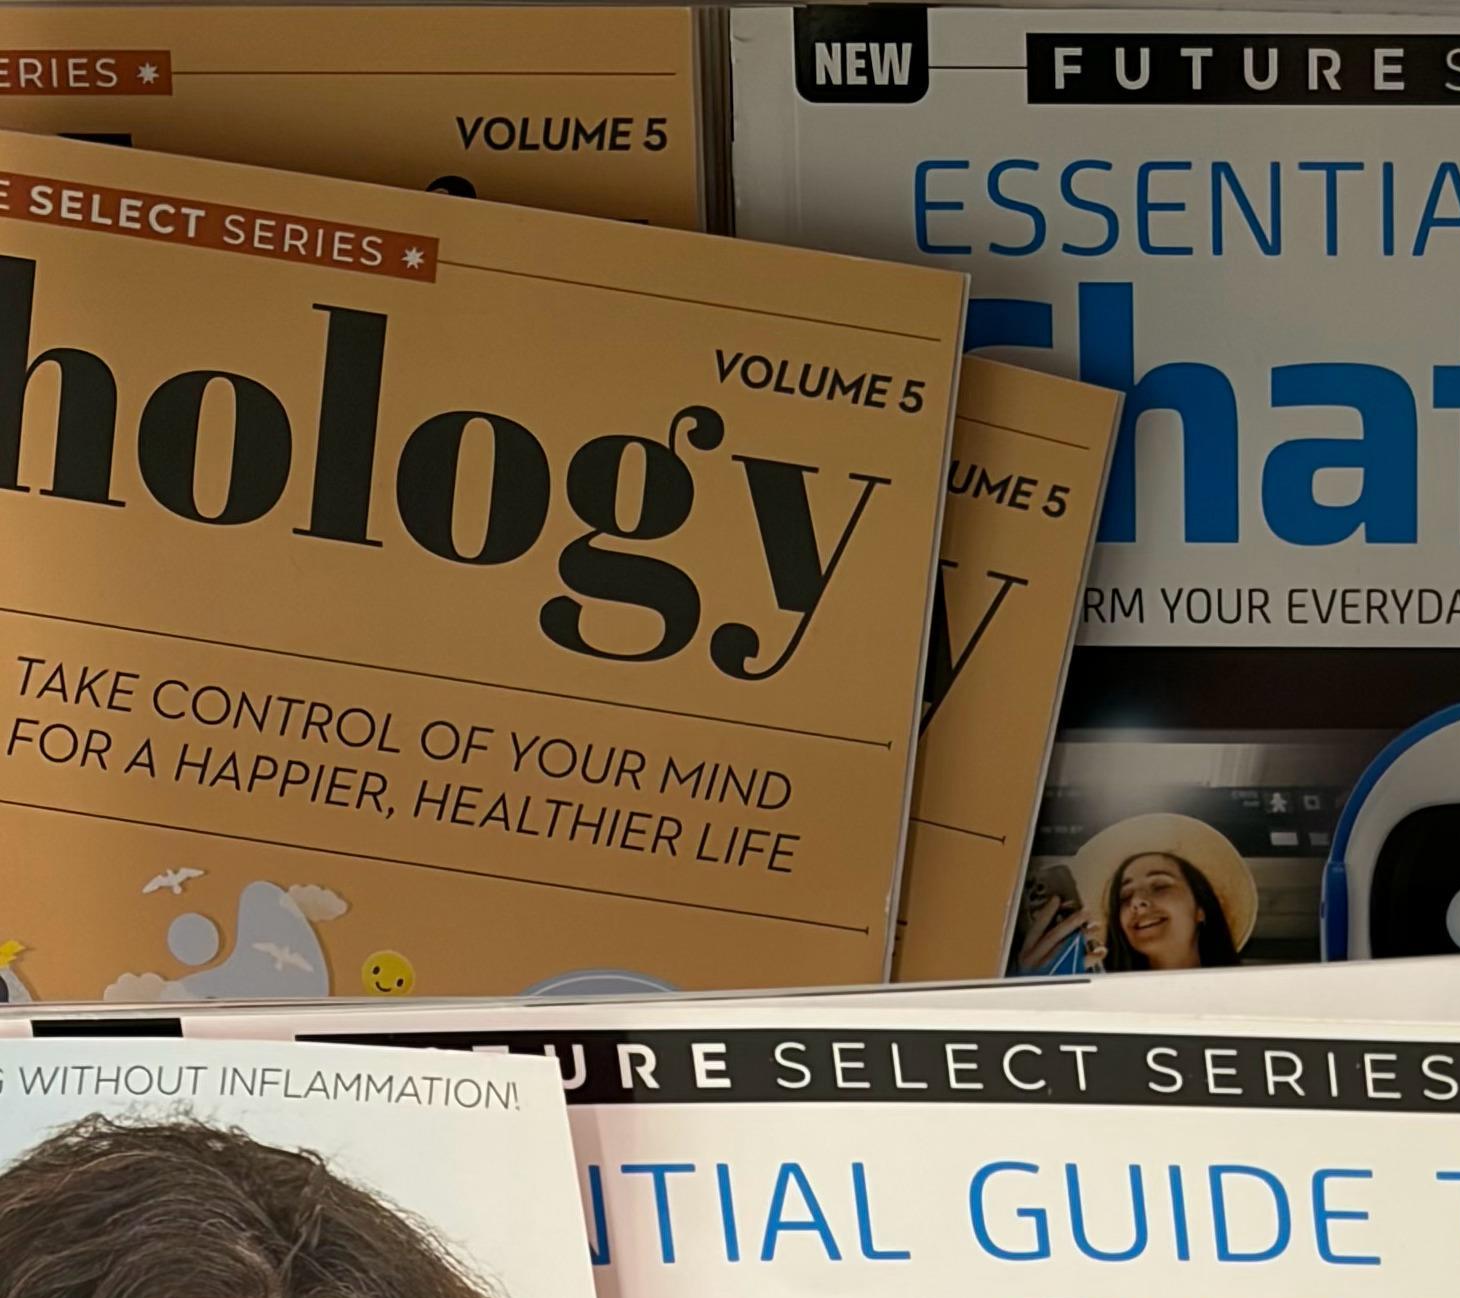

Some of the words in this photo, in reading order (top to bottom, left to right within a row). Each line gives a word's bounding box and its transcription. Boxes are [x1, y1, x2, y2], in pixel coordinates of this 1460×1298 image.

[815, 42, 912, 85] NEW
[1054, 47, 1404, 91] FUTURE
[456, 117, 632, 151] VOLUME
[643, 118, 668, 151] 5
[30, 185, 204, 237] SELECT
[223, 214, 383, 267] SERIES
[714, 349, 890, 409] VOLUME
[899, 380, 926, 414] 5
[1161, 587, 1271, 625] YOUR
[15, 656, 137, 713] TAKE
[151, 679, 402, 754] CONTROL
[419, 720, 495, 765] OF
[510, 732, 647, 791] YOUR
[659, 756, 793, 811] MIND
[6, 717, 112, 771] FOR
[125, 740, 157, 778] A
[173, 745, 396, 820] HAPPIER,
[412, 780, 685, 857] HEALTHIER
[695, 820, 802, 874] LIFE
[20, 1066, 208, 1098] WITHOUT
[219, 1067, 521, 1110] INFLAMMATION!
[774, 1041, 1098, 1091] SELECT
[1145, 1047, 1460, 1101] SERIES
[968, 1161, 1381, 1266] GUIDE
